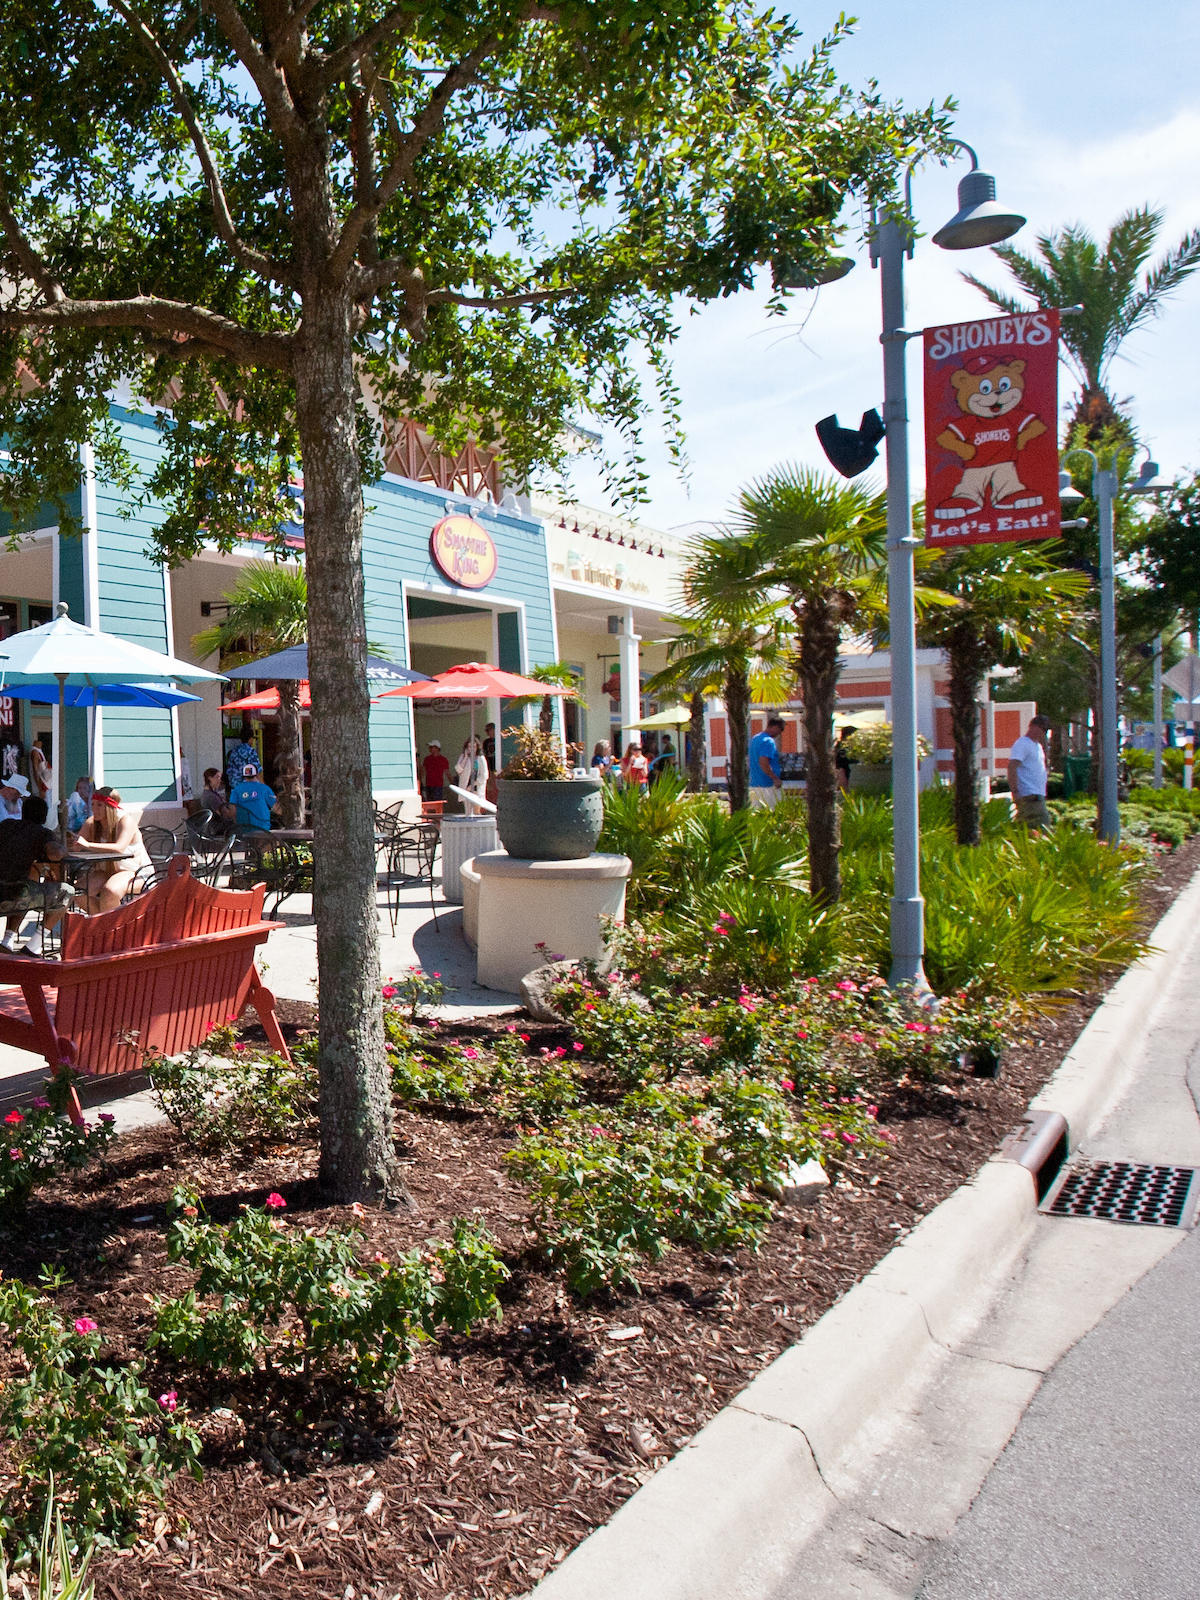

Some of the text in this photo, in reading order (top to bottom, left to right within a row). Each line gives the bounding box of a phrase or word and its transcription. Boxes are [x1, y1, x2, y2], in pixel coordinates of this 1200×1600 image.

[928, 313, 1053, 360] SHONEY'S
[930, 512, 1048, 538] Let's Eat!
